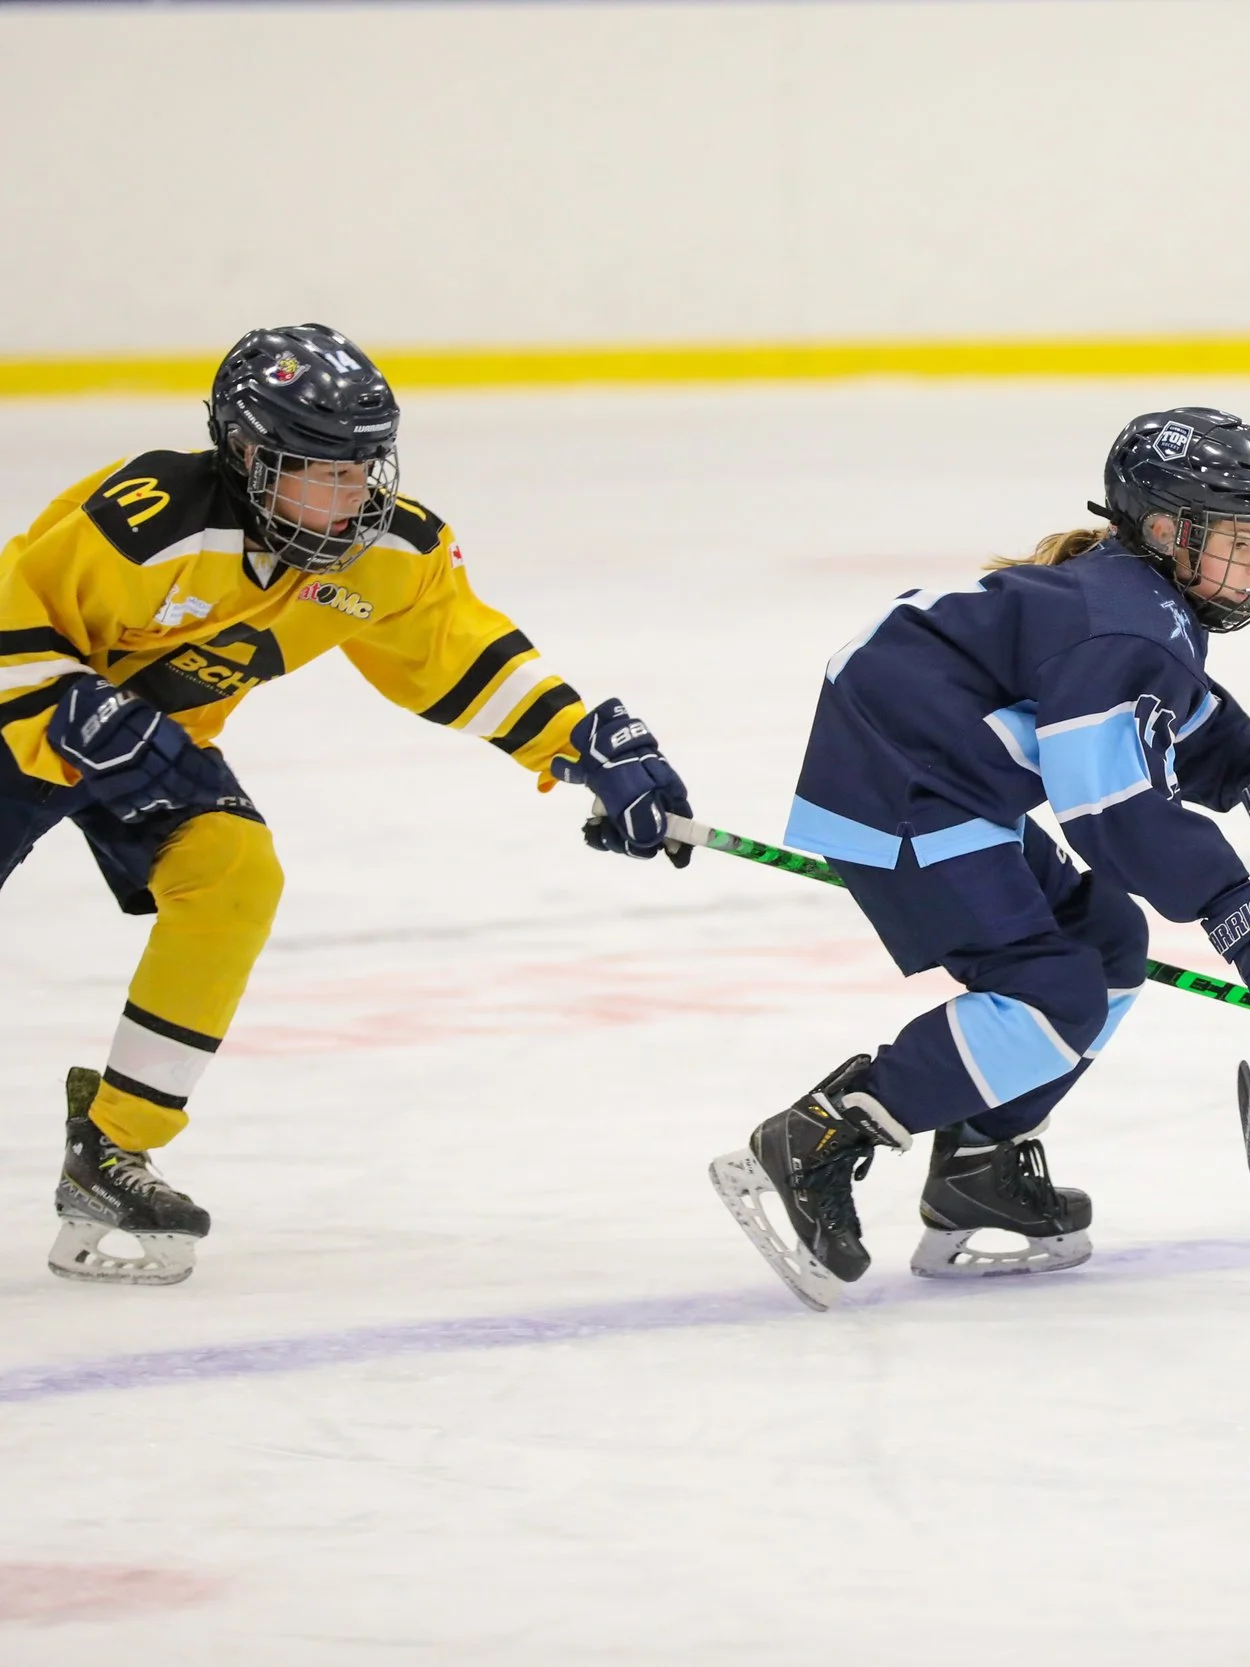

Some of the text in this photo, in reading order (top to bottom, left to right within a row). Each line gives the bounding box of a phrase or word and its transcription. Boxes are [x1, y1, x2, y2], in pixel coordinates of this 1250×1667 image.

[324, 349, 363, 374] 14
[1162, 430, 1188, 447] TOP
[91, 1184, 123, 1208] BAUER
